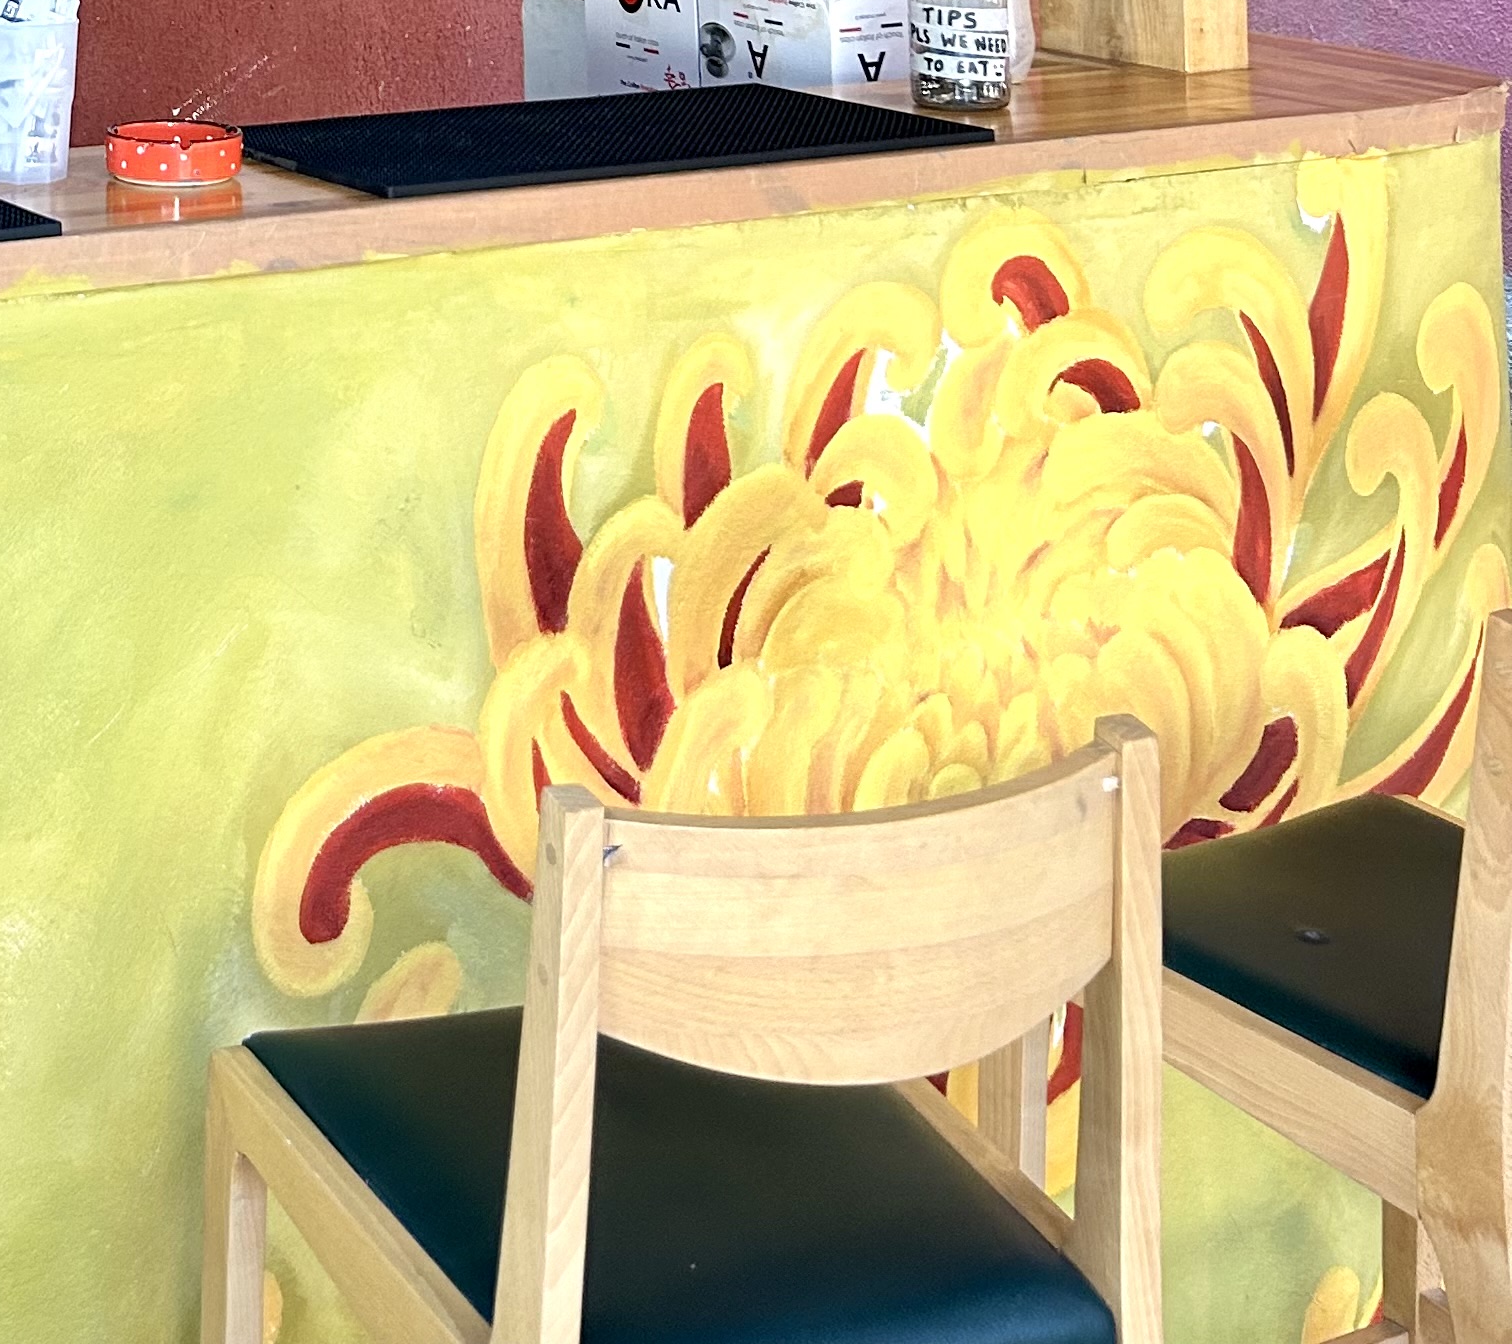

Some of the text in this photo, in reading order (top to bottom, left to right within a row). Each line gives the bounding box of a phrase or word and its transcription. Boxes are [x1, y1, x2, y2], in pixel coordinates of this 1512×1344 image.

[922, 7, 977, 29] TIPS
[940, 32, 968, 48] WE
[974, 36, 1007, 54] NEED
[923, 57, 988, 76] TO EAT
